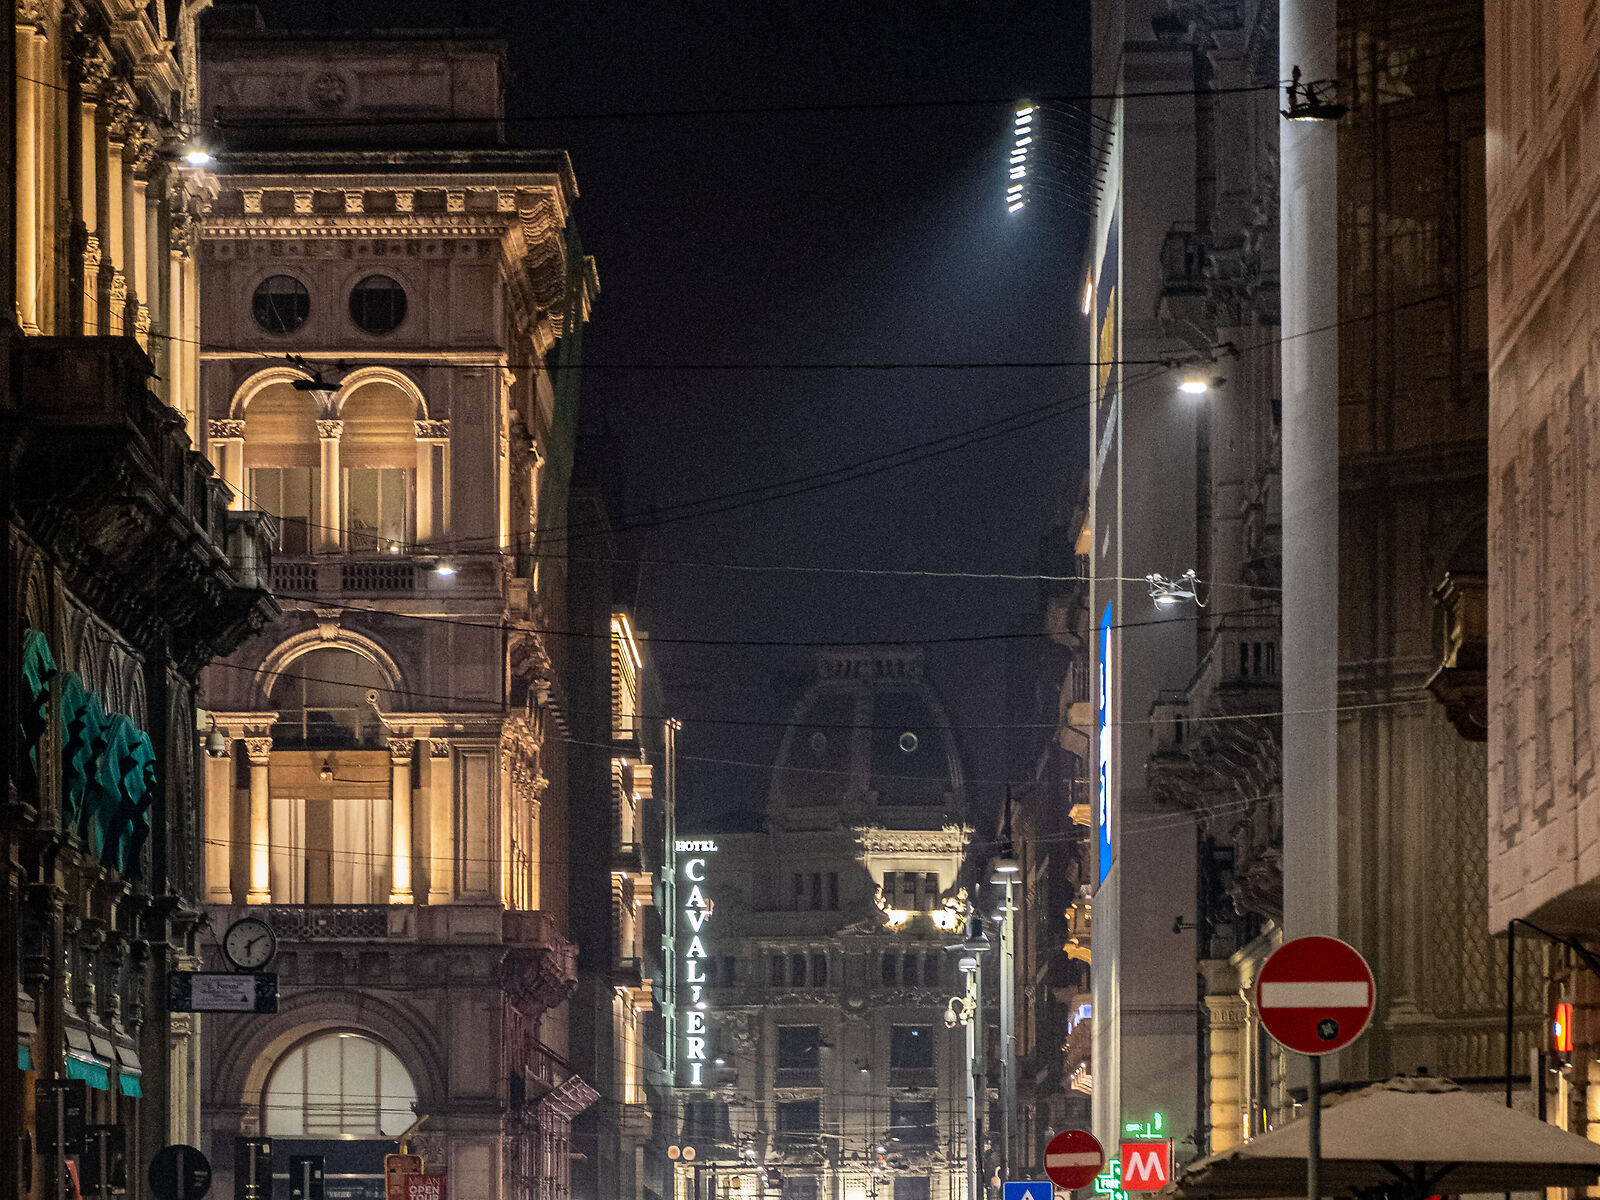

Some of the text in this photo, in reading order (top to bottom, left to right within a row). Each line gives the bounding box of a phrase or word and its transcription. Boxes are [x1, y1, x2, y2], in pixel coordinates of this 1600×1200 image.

[675, 840, 718, 852] HOTEL
[684, 858, 708, 1086] CAVALIERI
[1124, 1151, 1166, 1181] M
[408, 1185, 441, 1195] OPEN
